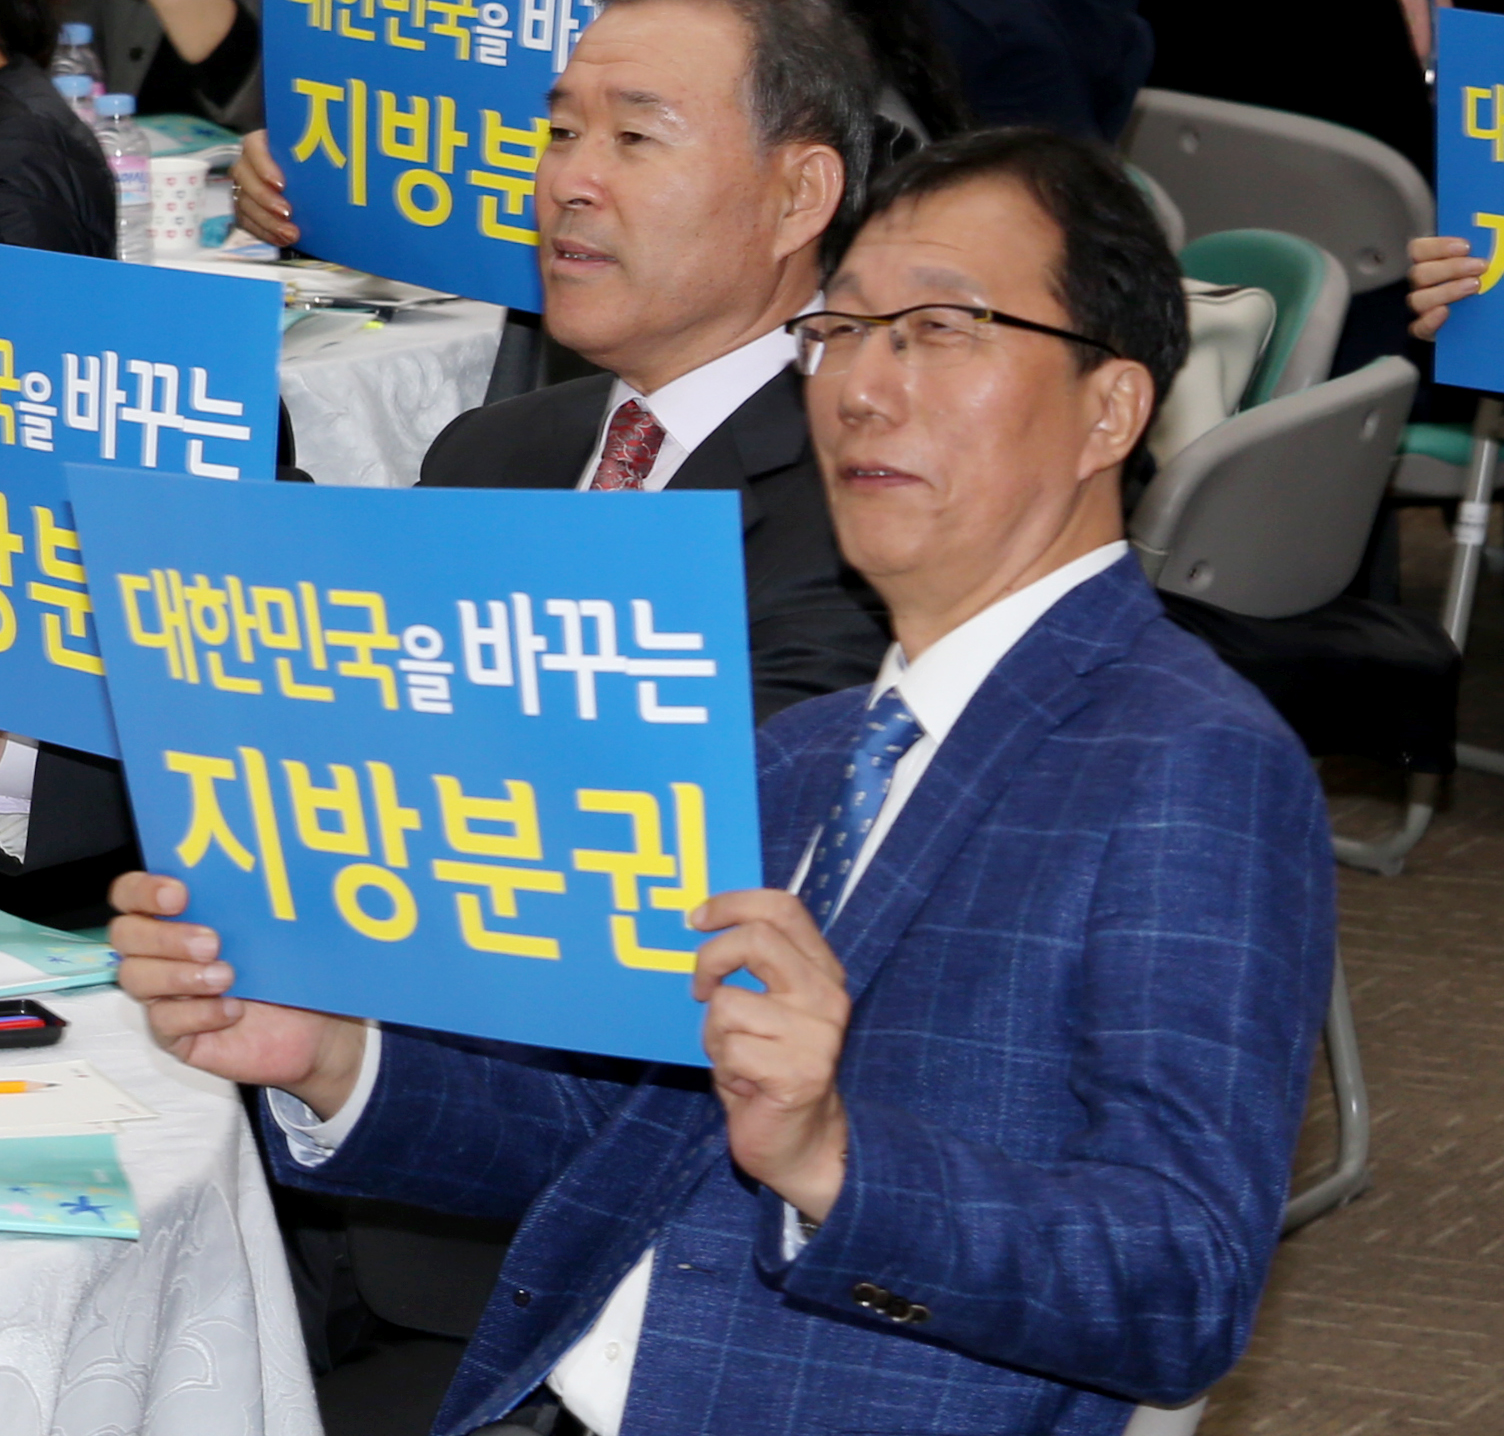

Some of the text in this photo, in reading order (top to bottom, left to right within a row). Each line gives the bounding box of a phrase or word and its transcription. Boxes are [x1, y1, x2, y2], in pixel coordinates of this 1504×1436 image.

[290, 76, 552, 249] 지방분
[60, 350, 252, 482] 바꾸는
[117, 569, 717, 723] 대한민국을 바꾸는
[164, 747, 710, 974] 지방분권
